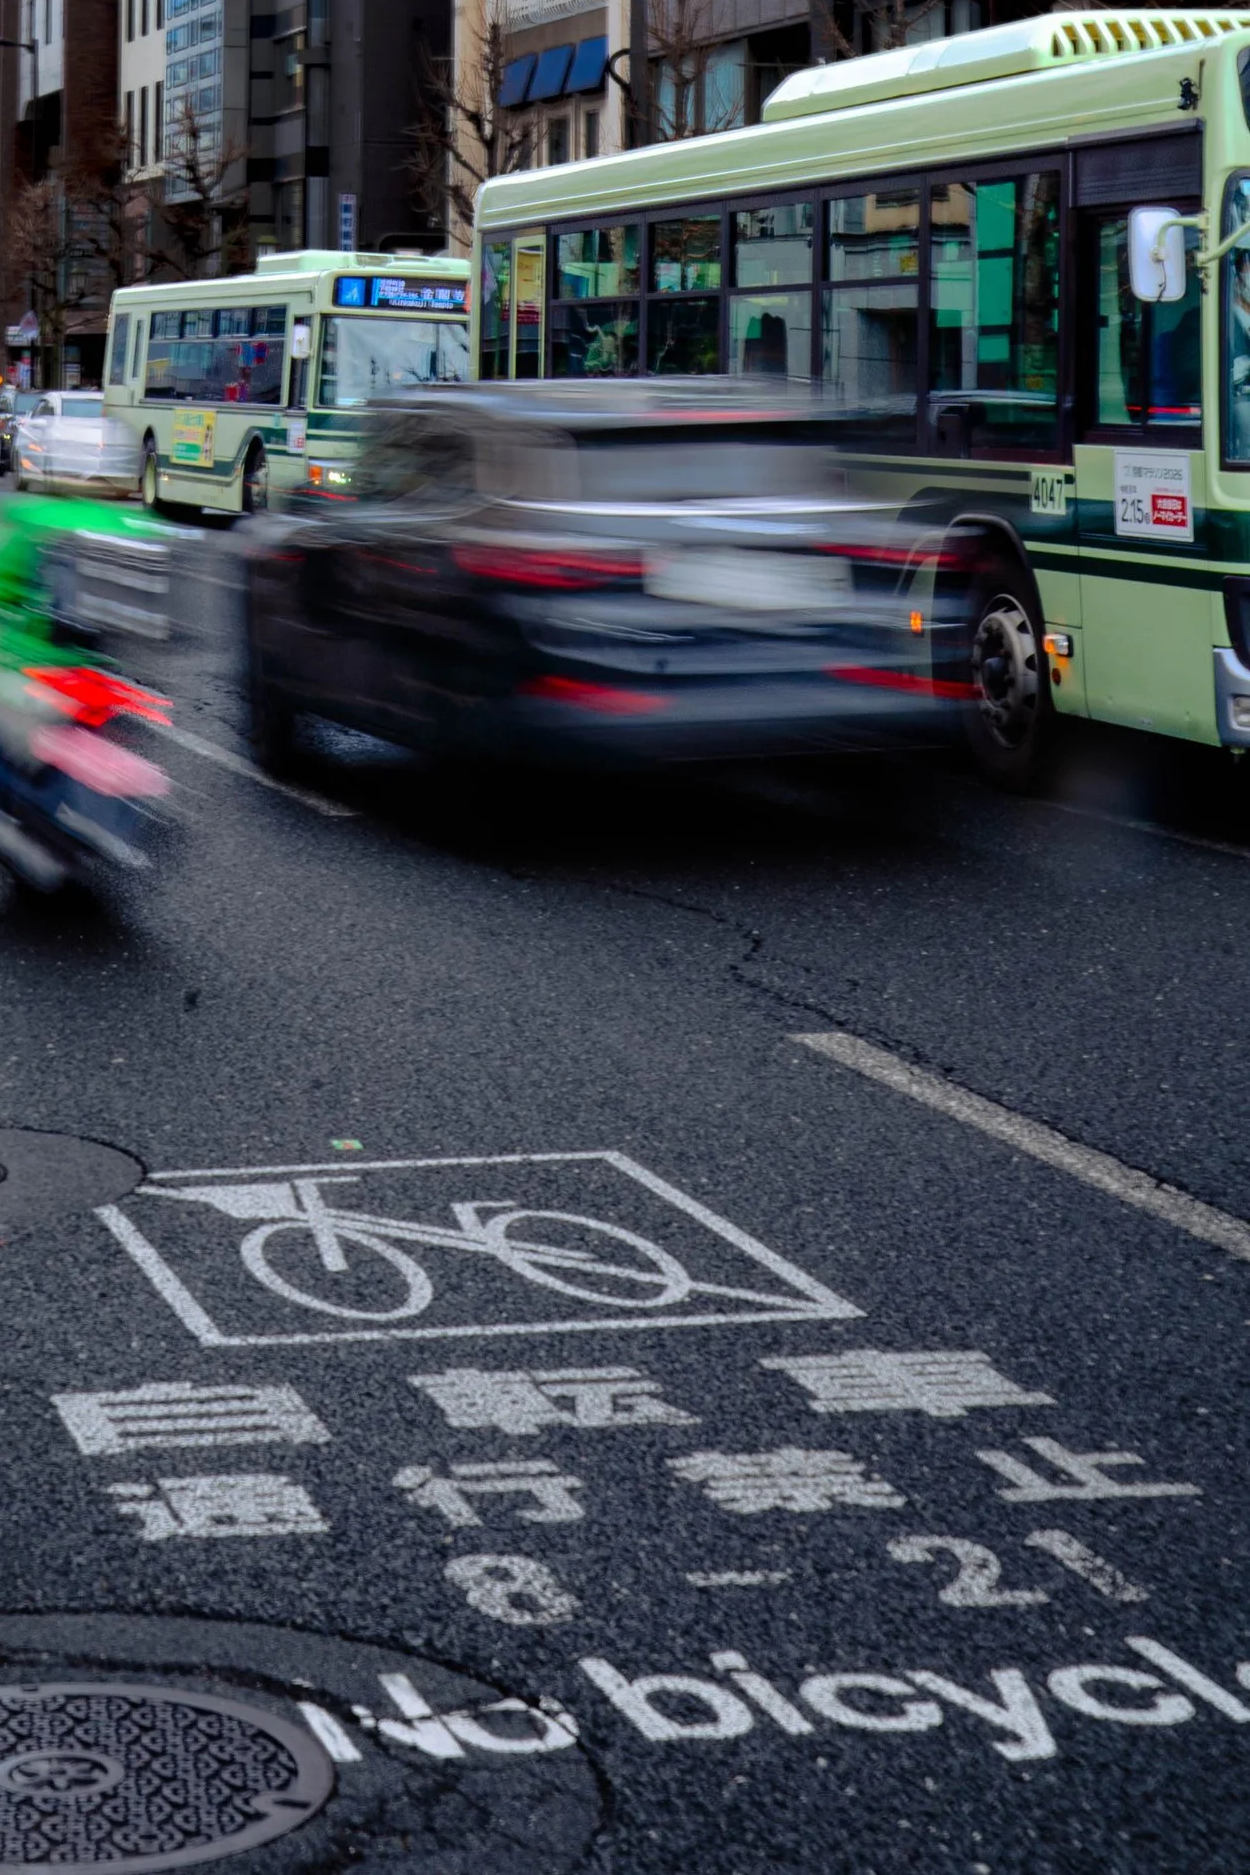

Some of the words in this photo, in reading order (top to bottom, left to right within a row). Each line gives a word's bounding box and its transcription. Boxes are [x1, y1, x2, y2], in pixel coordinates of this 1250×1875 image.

[1033, 476, 1064, 510] 4047
[50, 1349, 1058, 1455] 自転車
[106, 1435, 1202, 1541] 通行禁止
[296, 1672, 582, 1763] No
[577, 1636, 1250, 1761] bicycl
